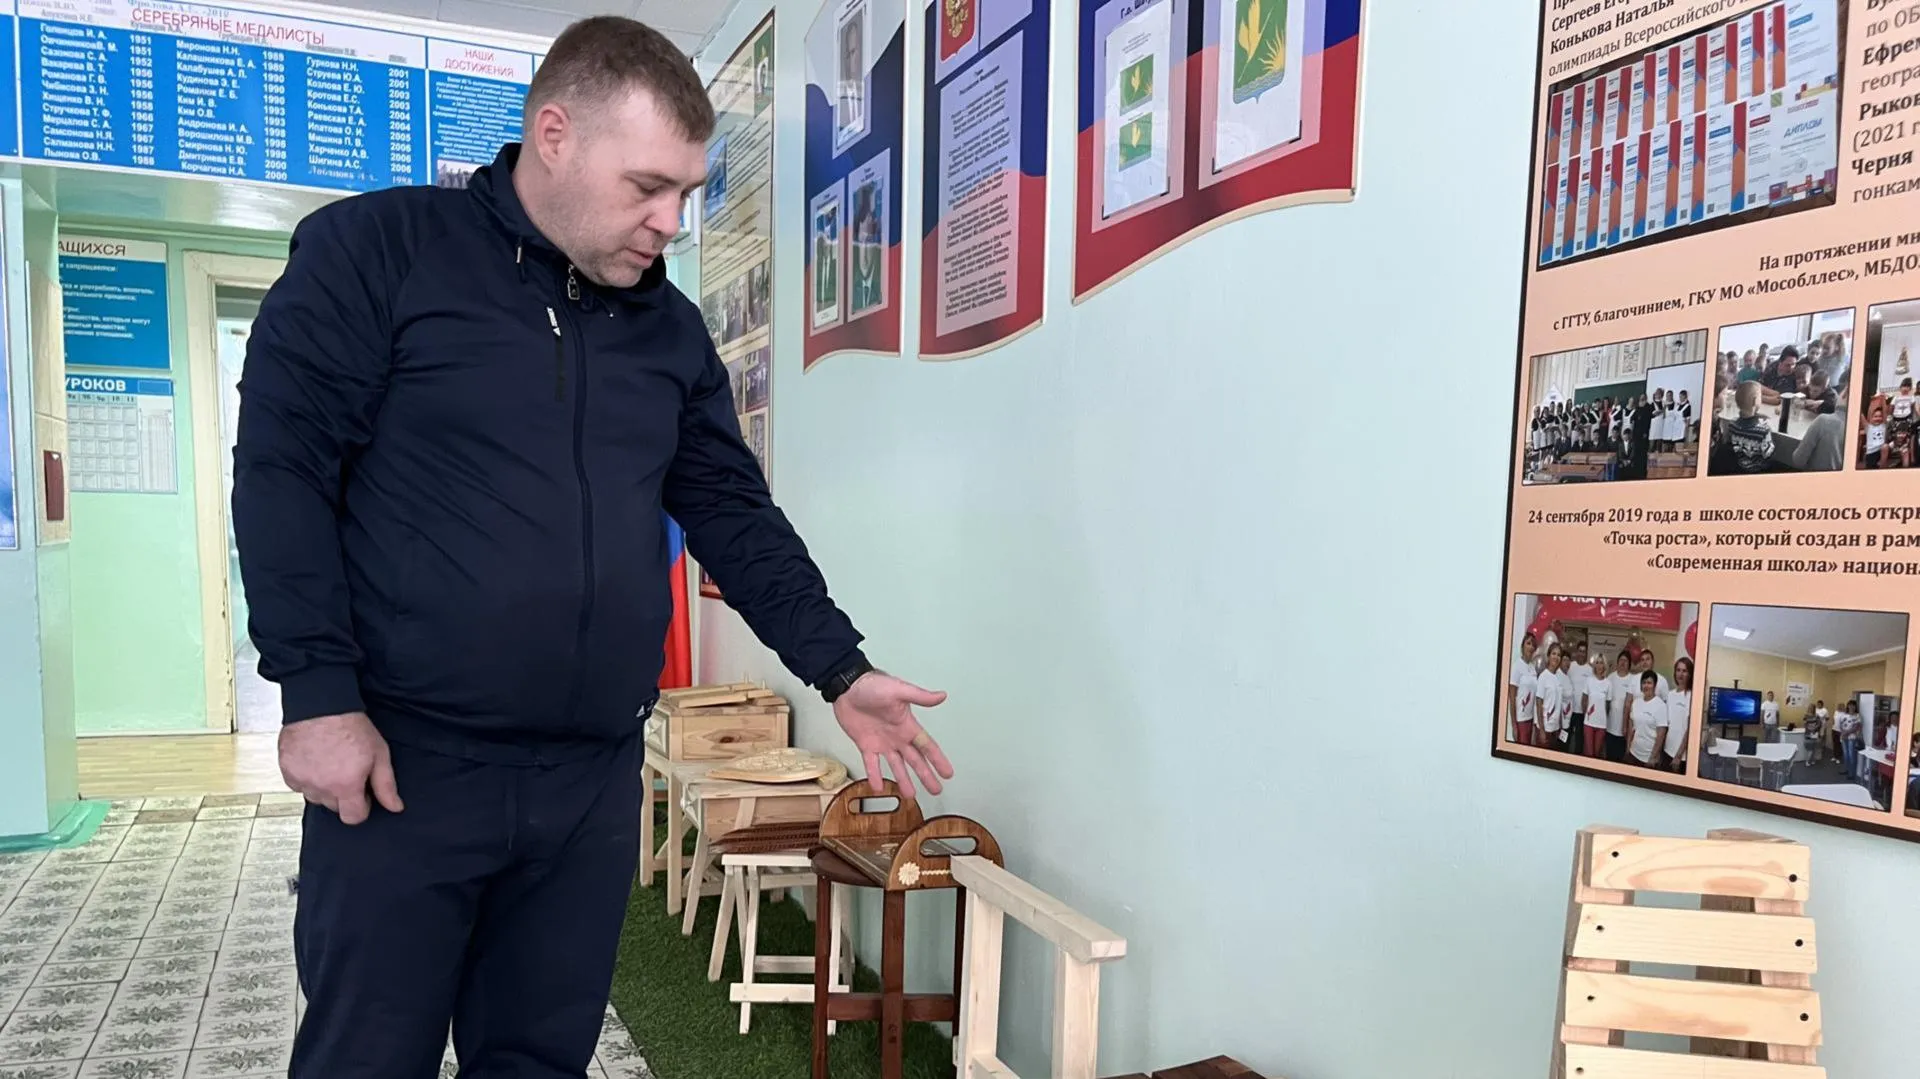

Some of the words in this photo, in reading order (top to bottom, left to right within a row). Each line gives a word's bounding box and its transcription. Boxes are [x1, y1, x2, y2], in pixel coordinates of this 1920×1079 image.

[132, 8, 232, 33] СЕРЕБРЯНЫЕ
[236, 22, 324, 45] МЕДАЛИСТЫ
[1551, 20, 1612, 54] Конькова
[1616, 0, 1674, 28] Наталья
[1552, 3, 1600, 32] Сергеев
[1548, 40, 1620, 77] олимпиады
[1624, 0, 1735, 48] Всероссийского
[1866, 20, 1888, 38] по
[465, 49, 495, 61] НАШИ
[389, 68, 409, 78] 2001
[444, 58, 514, 78] ДОСТИЖЕНИЯ
[307, 78, 342, 90] Козлова
[389, 79, 409, 88] 2001
[178, 128, 234, 142] Ворошилова
[1853, 120, 1905, 152] (2021
[178, 139, 223, 152] Смирнова
[265, 160, 287, 170] 2000
[1852, 150, 1914, 176] Черня
[265, 171, 287, 180] 2000
[1759, 255, 1779, 271] На
[1784, 236, 1891, 269] протяжении
[1553, 320, 1560, 330] с
[1562, 312, 1590, 330] ГГТУ,
[1594, 298, 1684, 324] благочинием,
[1688, 288, 1716, 306] ГКУ
[1720, 284, 1744, 300] МО
[1748, 268, 1859, 295] «Мособллес»,
[1864, 254, 1920, 277] МБДО
[1528, 510, 1543, 523] 24
[1546, 508, 1604, 526] сентября
[1608, 508, 1642, 522] 2019
[1646, 510, 1678, 524] года
[1683, 510, 1692, 521] в
[1700, 508, 1754, 522] школе
[1758, 507, 1862, 520] состоялось
[1603, 530, 1650, 545] «Точка
[1656, 534, 1712, 548] роста»,
[1716, 530, 1791, 550] который
[1796, 534, 1860, 549] создан
[1866, 534, 1877, 546] в
[1647, 554, 1762, 572] «Современная
[1768, 559, 1838, 573] школа»
[1843, 560, 1920, 577] национ
